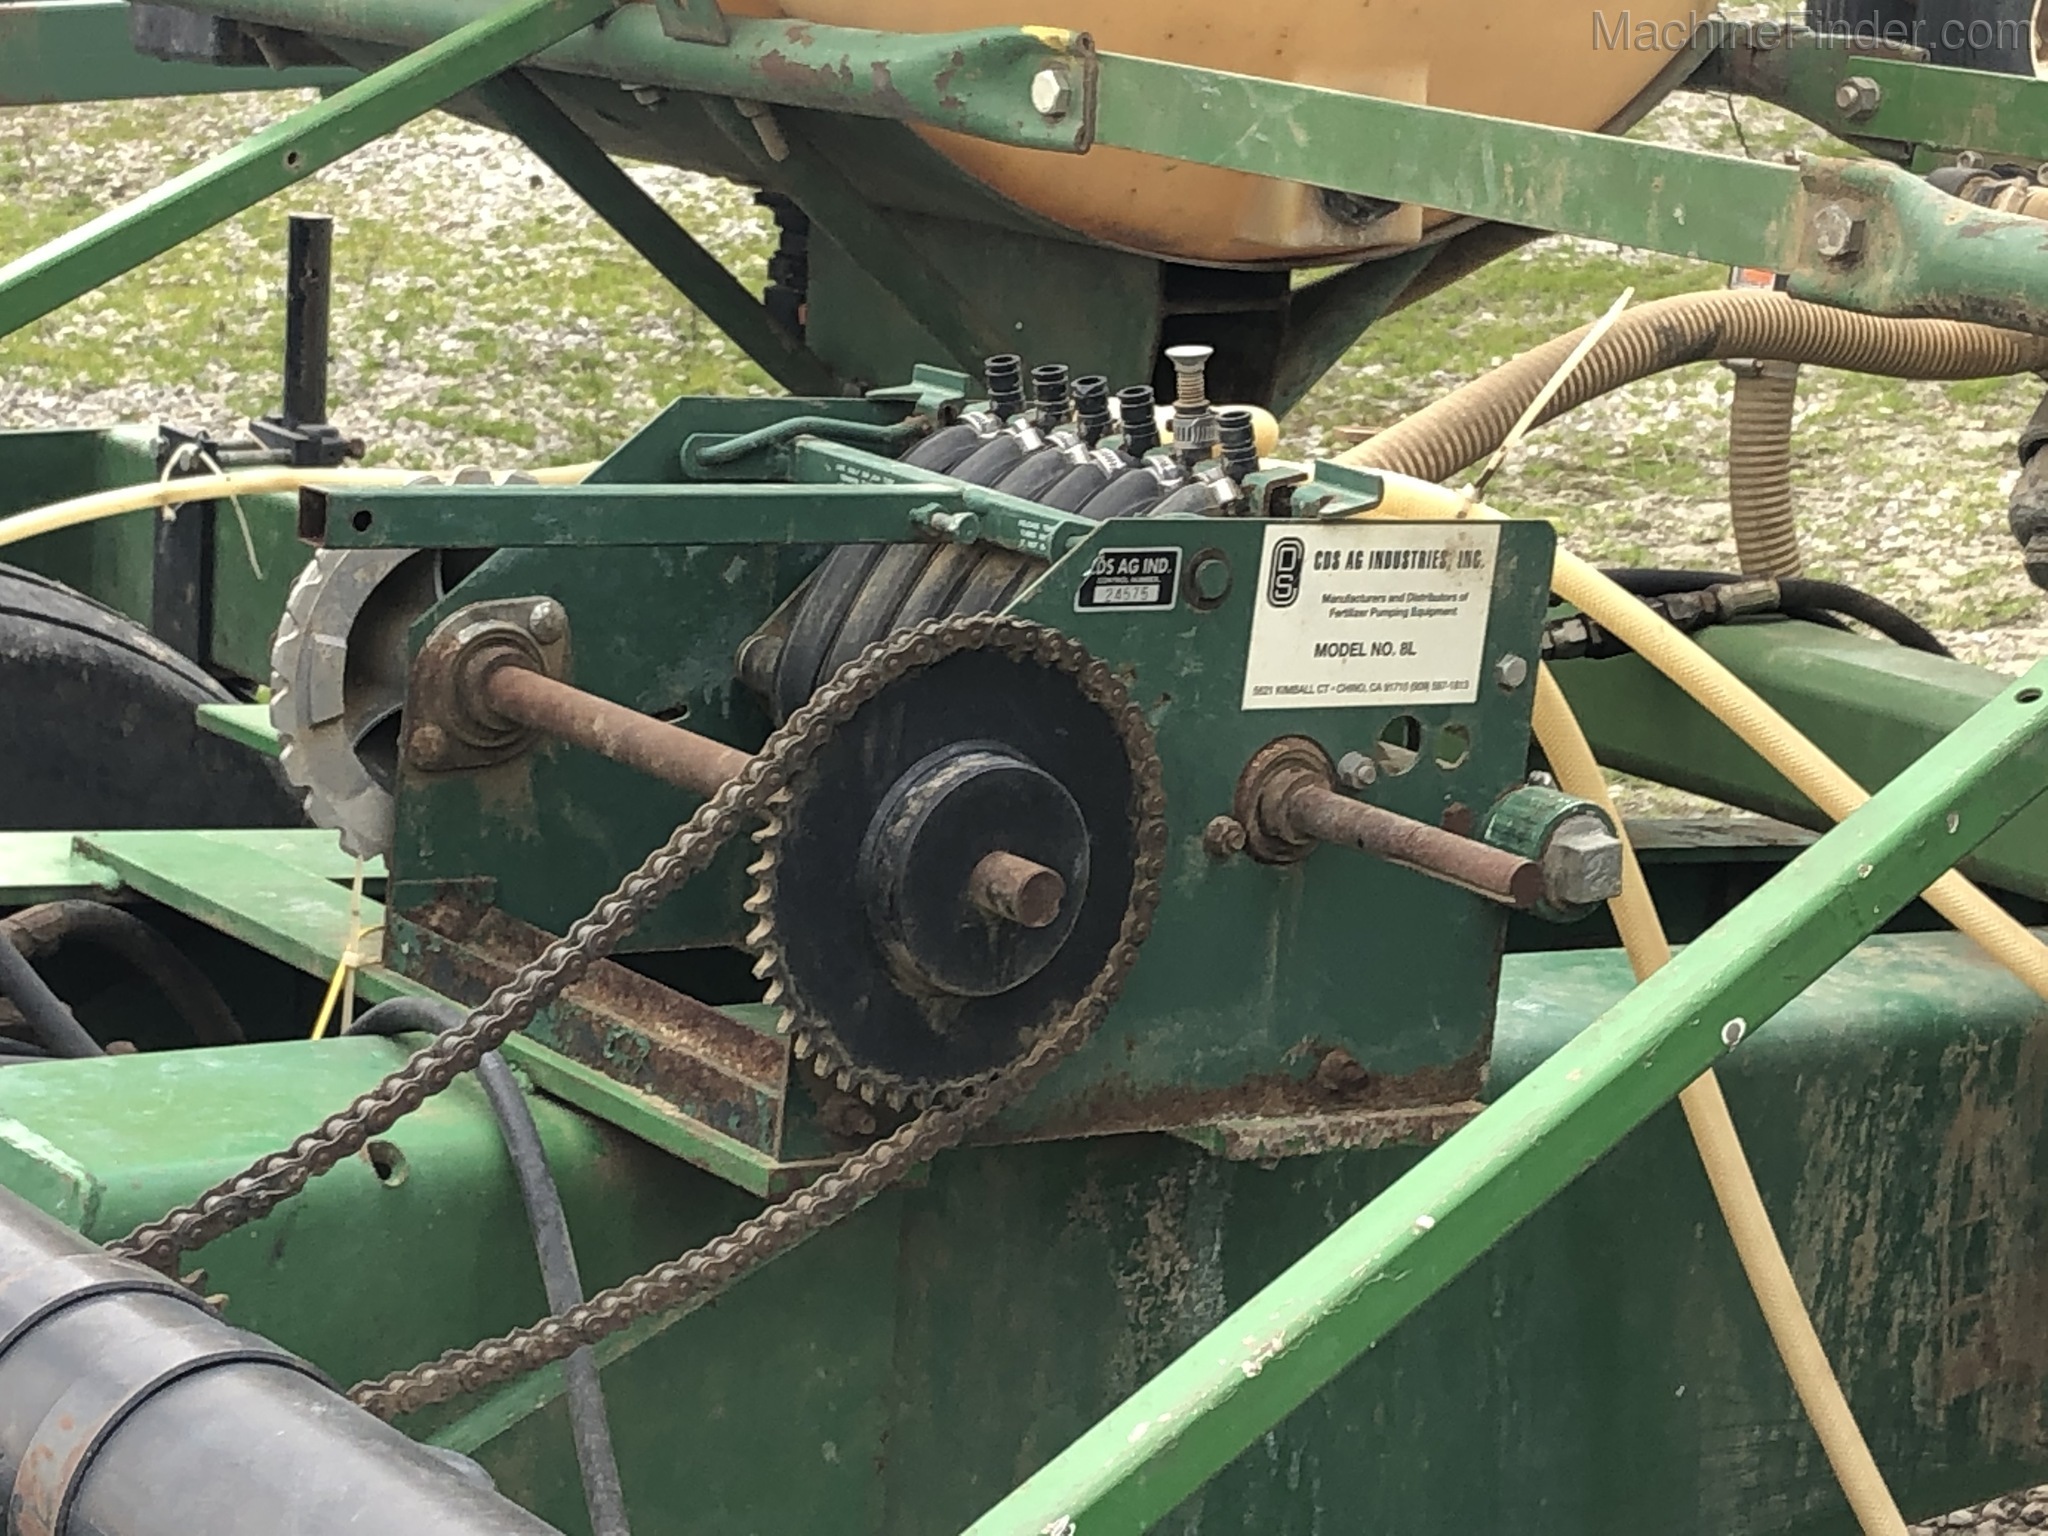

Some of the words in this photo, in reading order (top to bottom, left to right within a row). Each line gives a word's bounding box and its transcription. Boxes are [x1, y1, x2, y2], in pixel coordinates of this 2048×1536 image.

[1116, 557, 1140, 575] AG
[1141, 557, 1173, 574] IND.
[1313, 550, 1341, 571] CDS
[1345, 550, 1364, 570] AG
[1367, 549, 1451, 571] INDUSTRIES,
[1457, 549, 1485, 570] INC.
[1105, 586, 1149, 601] 24575
[1321, 593, 1386, 603] Manufacturers
[1388, 593, 1406, 603] and
[1406, 592, 1458, 603] Distributors
[1458, 592, 1469, 602] of
[1328, 607, 1369, 618] Fertilizer
[1370, 607, 1409, 619] Pumping
[1410, 606, 1458, 618] Equipment
[1313, 642, 1367, 658] MODEL
[1370, 641, 1396, 657] NO.
[1399, 641, 1417, 656] 8L
[1316, 683, 1330, 694] CT
[1369, 682, 1382, 693] CA
